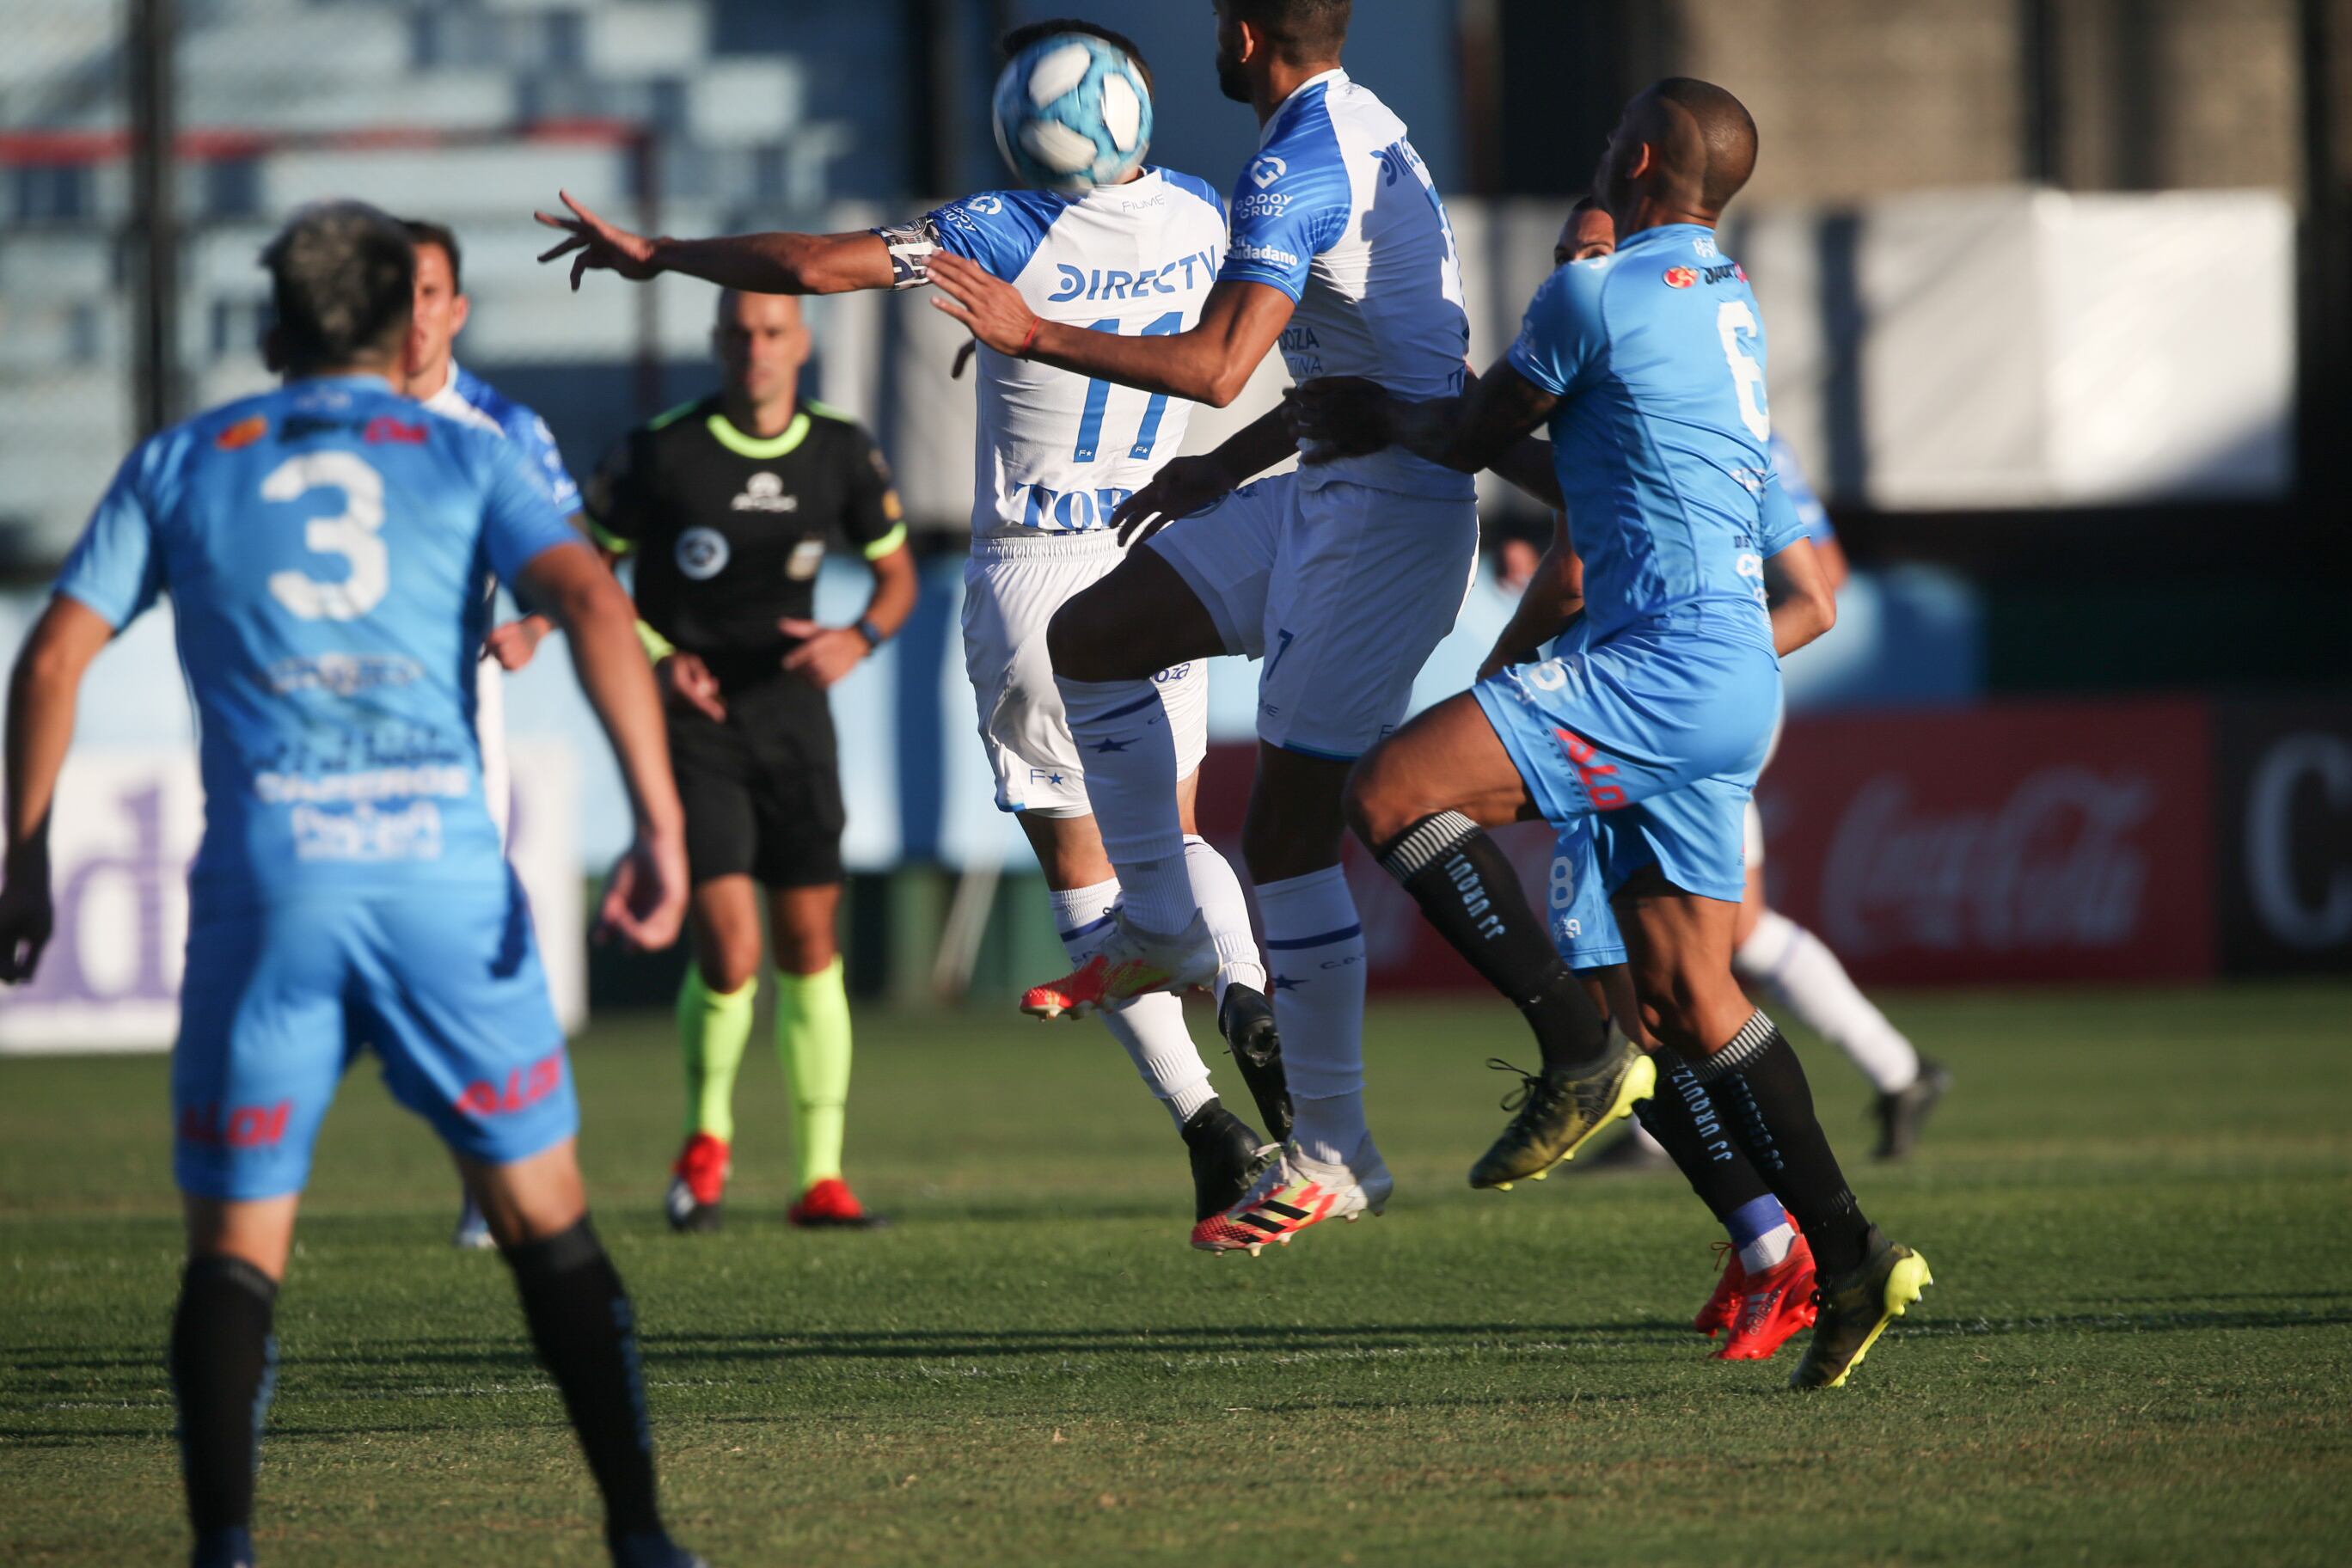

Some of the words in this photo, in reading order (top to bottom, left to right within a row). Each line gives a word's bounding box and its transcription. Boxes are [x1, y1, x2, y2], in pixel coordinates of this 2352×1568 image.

[1121, 193, 1166, 213] FIUME
[1235, 193, 1294, 211] GODOY
[1240, 205, 1284, 219] CRUZ
[1047, 244, 1217, 303] DIRECTV
[1072, 311, 1184, 463] 11
[1717, 300, 1771, 443] 6
[260, 450, 389, 622] 3
[1266, 628, 1294, 681] 7
[1550, 856, 1574, 910] 8
[1707, 1140, 1734, 1161] JJ
